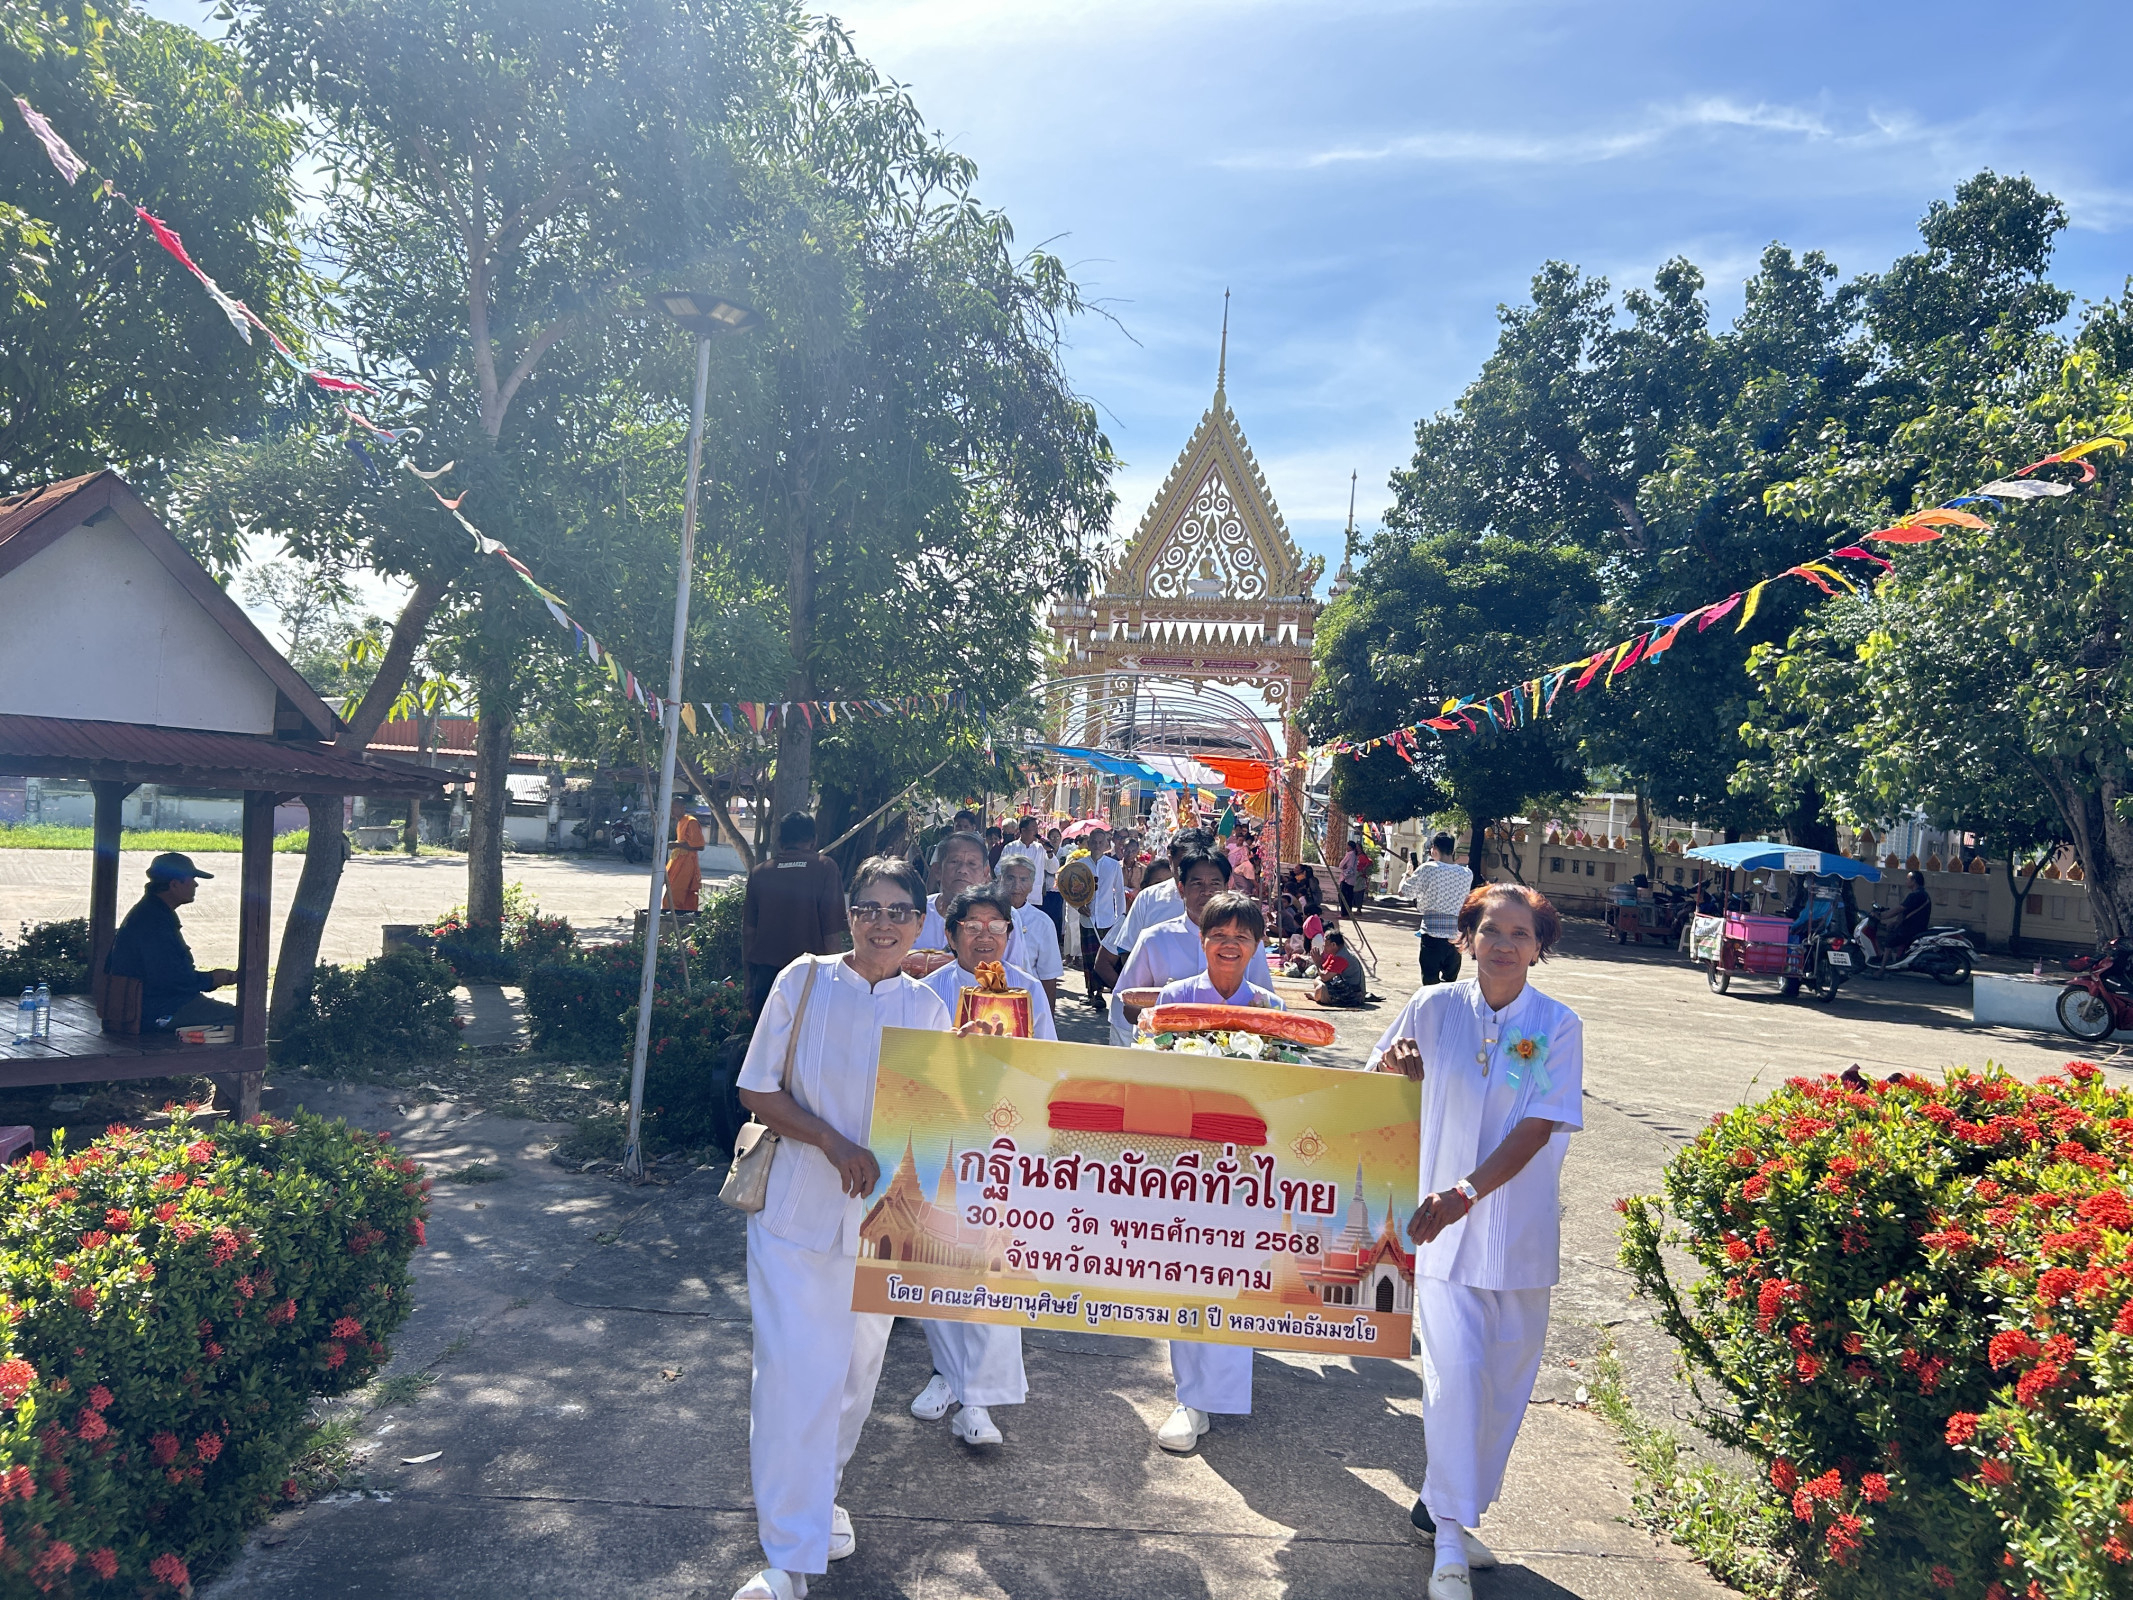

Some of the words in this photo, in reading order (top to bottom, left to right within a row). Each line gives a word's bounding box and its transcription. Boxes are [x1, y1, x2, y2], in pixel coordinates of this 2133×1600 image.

[960, 1138, 1335, 1214] กฐินสามัคคีทั่วไทย
[966, 1205, 1054, 1232] 30,000
[1067, 1207, 1099, 1235] วัด
[1111, 1217, 1245, 1249] พุทธศักราช
[1255, 1231, 1320, 1255] 2568
[1006, 1240, 1272, 1290] จังหวัดมหาสารคาม
[888, 1277, 922, 1300] โดย
[931, 1287, 1080, 1318] คณะศิษยานุศิษย์
[1085, 1301, 1169, 1323] บูชาธรรม
[1177, 1309, 1198, 1326] 81
[1208, 1306, 1222, 1327] ปี
[1229, 1314, 1376, 1340] หลวงพ่อธัมมชโย
